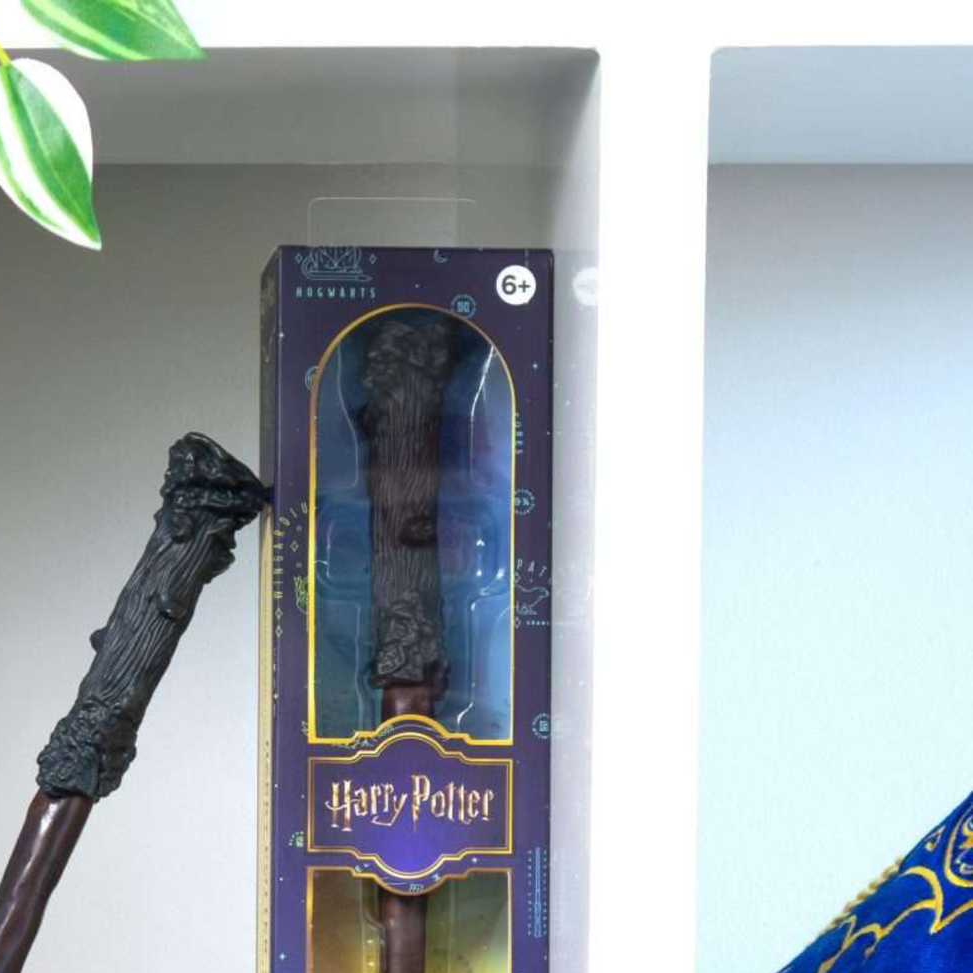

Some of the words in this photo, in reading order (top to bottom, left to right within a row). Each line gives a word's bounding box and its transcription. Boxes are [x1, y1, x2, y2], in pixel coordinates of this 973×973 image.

[295, 286, 376, 299] HOGWARTS
[501, 274, 531, 295] 6+
[325, 779, 408, 831] Harry
[411, 774, 494, 832] Potter
